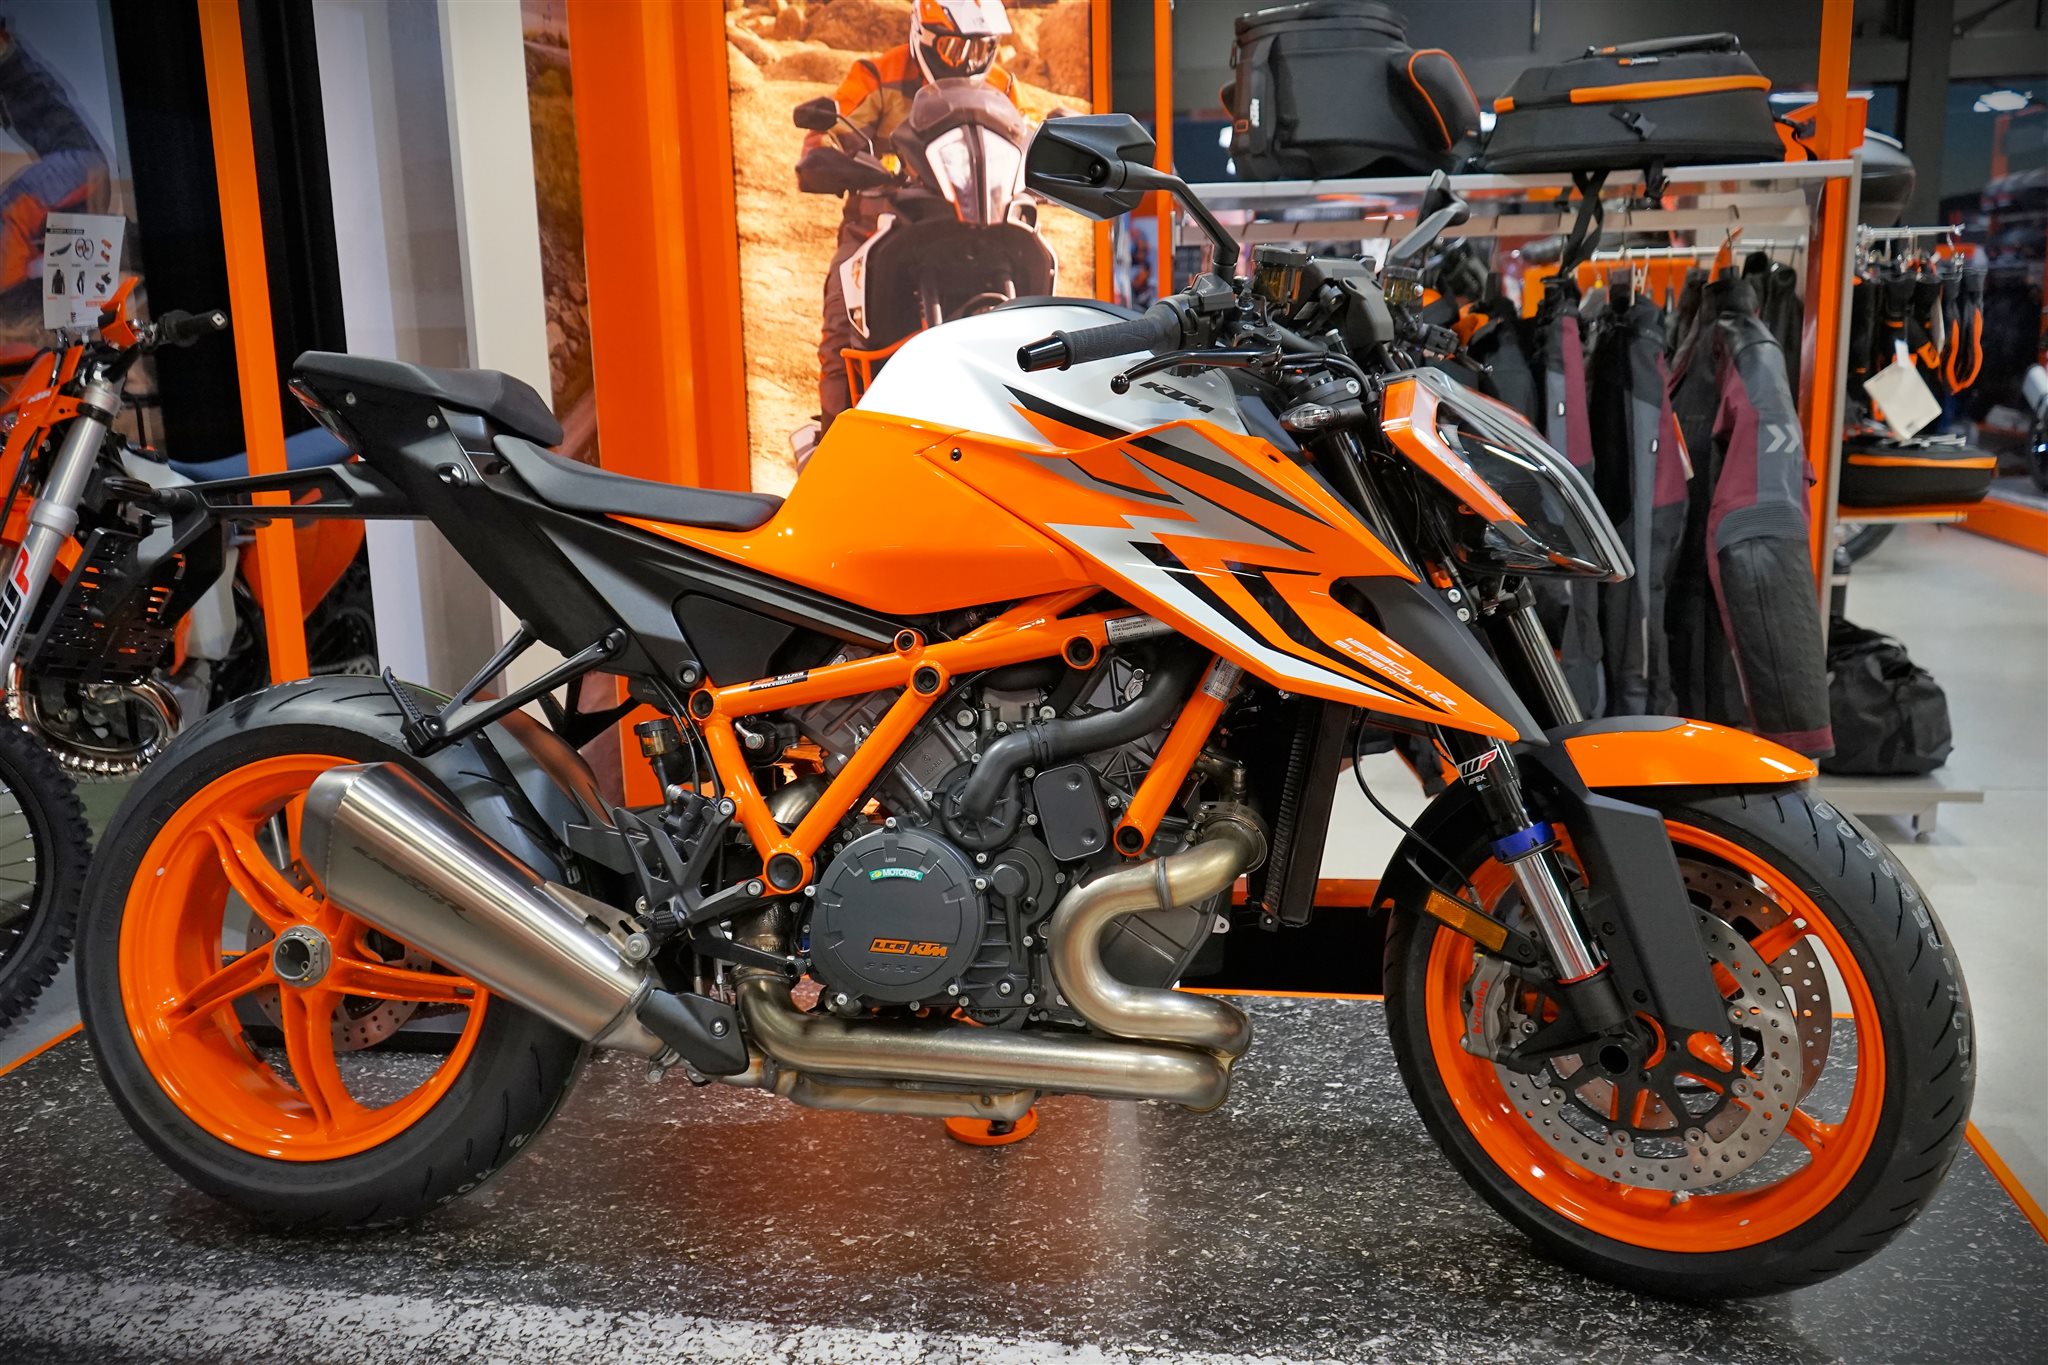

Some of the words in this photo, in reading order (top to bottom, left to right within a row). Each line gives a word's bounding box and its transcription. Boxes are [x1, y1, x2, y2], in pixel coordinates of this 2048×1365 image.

[1139, 381, 1215, 413] KTM
[1457, 748, 1498, 778] WP
[882, 868, 919, 880] MOTOREX
[909, 942, 948, 958] KTM
[1471, 980, 1489, 1034] brembo
